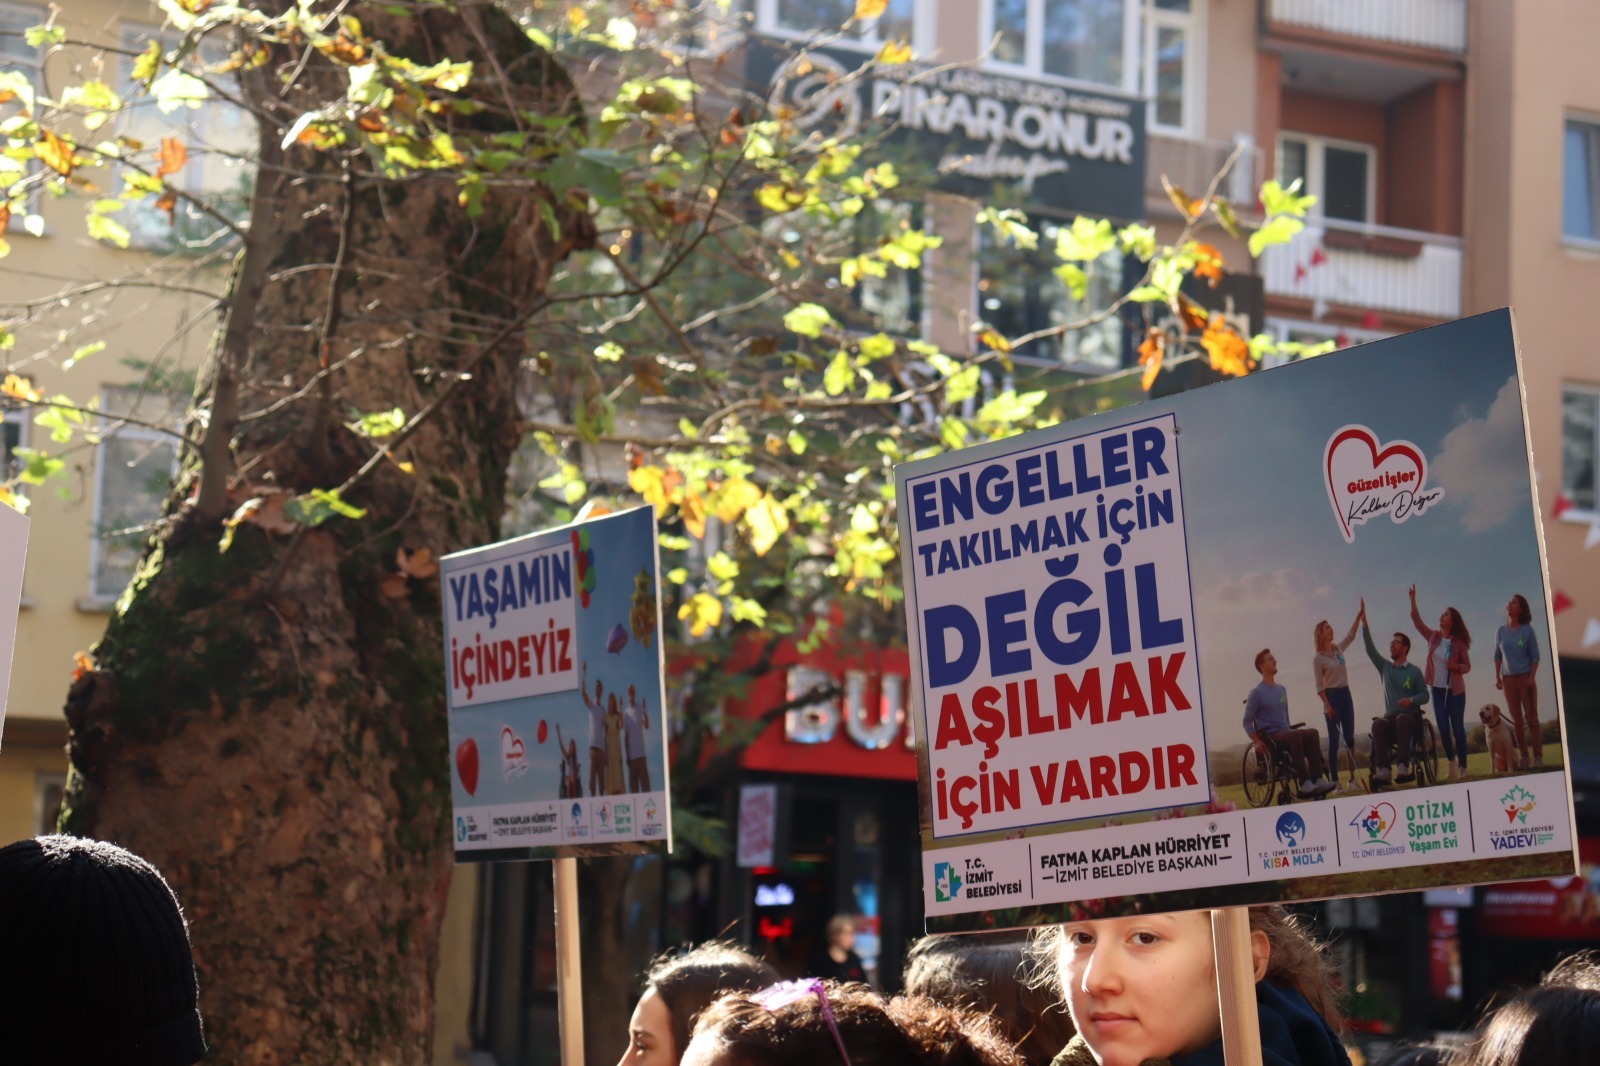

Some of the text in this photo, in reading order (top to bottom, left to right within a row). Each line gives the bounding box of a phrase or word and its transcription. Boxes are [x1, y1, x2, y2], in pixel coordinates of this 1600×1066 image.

[873, 78, 1134, 165] PINAR ONUR
[912, 426, 1170, 532] ENGELLER
[1347, 471, 1415, 494] Güzel İşler
[1347, 495, 1391, 526] Kalbe
[918, 484, 1175, 577] TAKILMAK İÇİN
[449, 550, 572, 629] YAŞAMIN
[923, 543, 1185, 689] DEĞİL
[452, 617, 572, 700] İÇİNDEYİZ
[786, 665, 918, 749] BU
[934, 651, 1193, 760] AŞILMAK
[936, 743, 1199, 829] İÇİN VARDIR
[1406, 800, 1455, 821] OTİZM
[1408, 820, 1457, 840] Spor ve
[1409, 836, 1458, 854] Yaşam Evi
[1491, 834, 1533, 850] YADEV
[965, 857, 986, 869] T.C.
[1041, 833, 1231, 869] FATMA KAPLAN HÜRRİYET
[1263, 852, 1324, 869] KISA MOLA
[965, 869, 994, 884] İZMİT
[1056, 854, 1218, 883] İZMİT BELEDİYE BAŞKANI
[966, 883, 1023, 899] BELEDİYESİ
